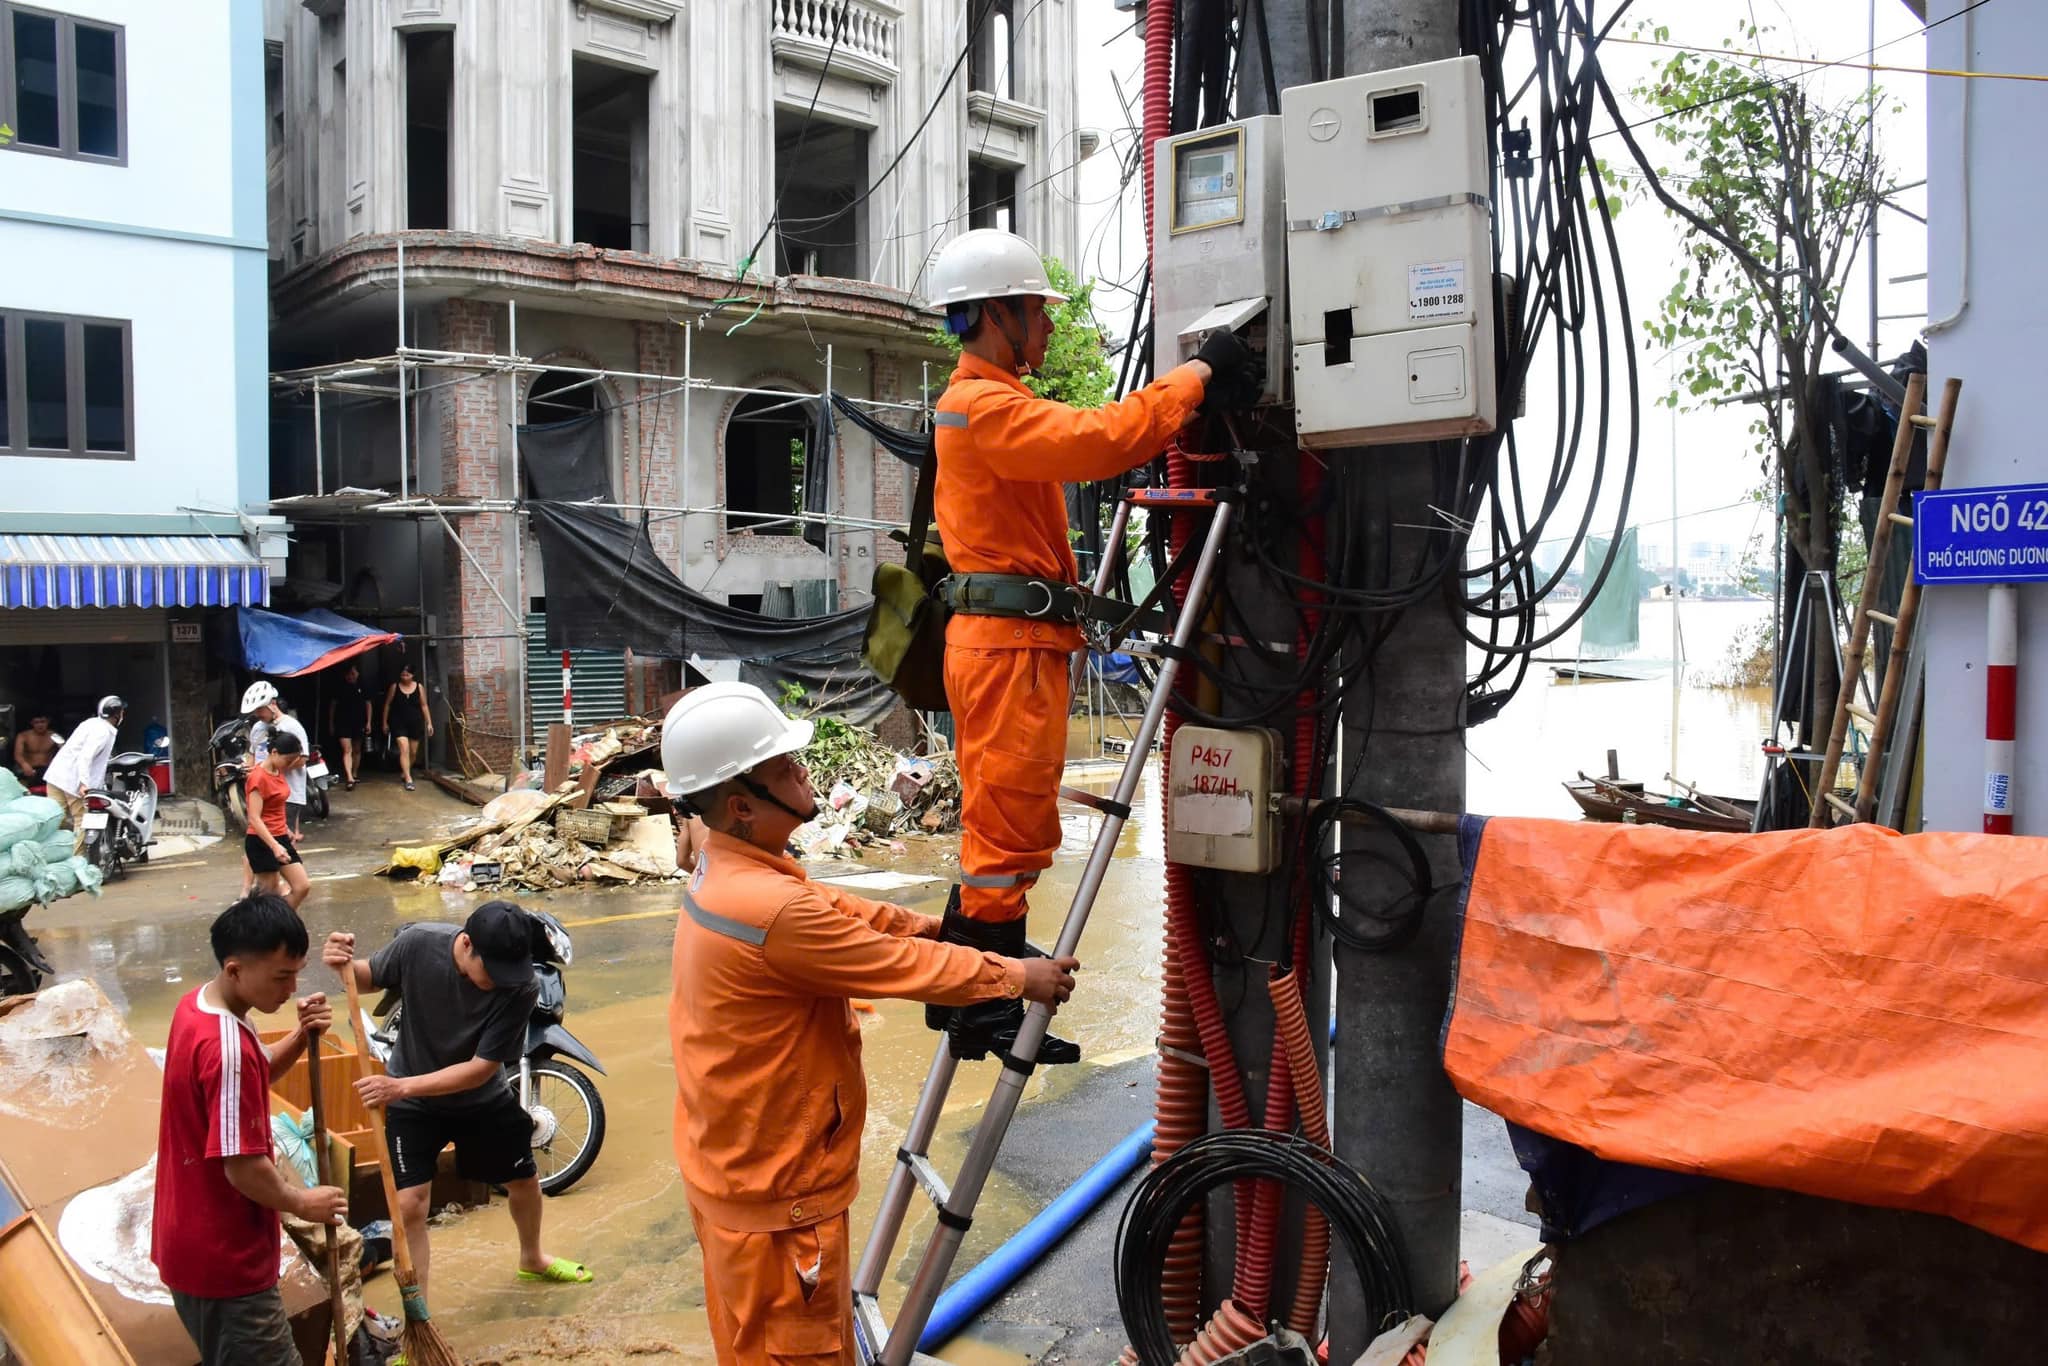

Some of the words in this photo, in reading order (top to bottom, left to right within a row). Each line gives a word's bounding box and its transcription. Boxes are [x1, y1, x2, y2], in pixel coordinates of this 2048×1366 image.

[1418, 296, 1440, 307] 1900
[1442, 294, 1464, 304] 1288
[1951, 495, 2010, 533] NGÕ
[2017, 501, 2048, 531] 42
[1928, 544, 1954, 568] PHỐ
[1955, 547, 2006, 568] CHƯƠNG
[2009, 546, 2048, 565] DƯƠN
[1191, 745, 1233, 767] P457
[1192, 774, 1237, 796] 187/H
